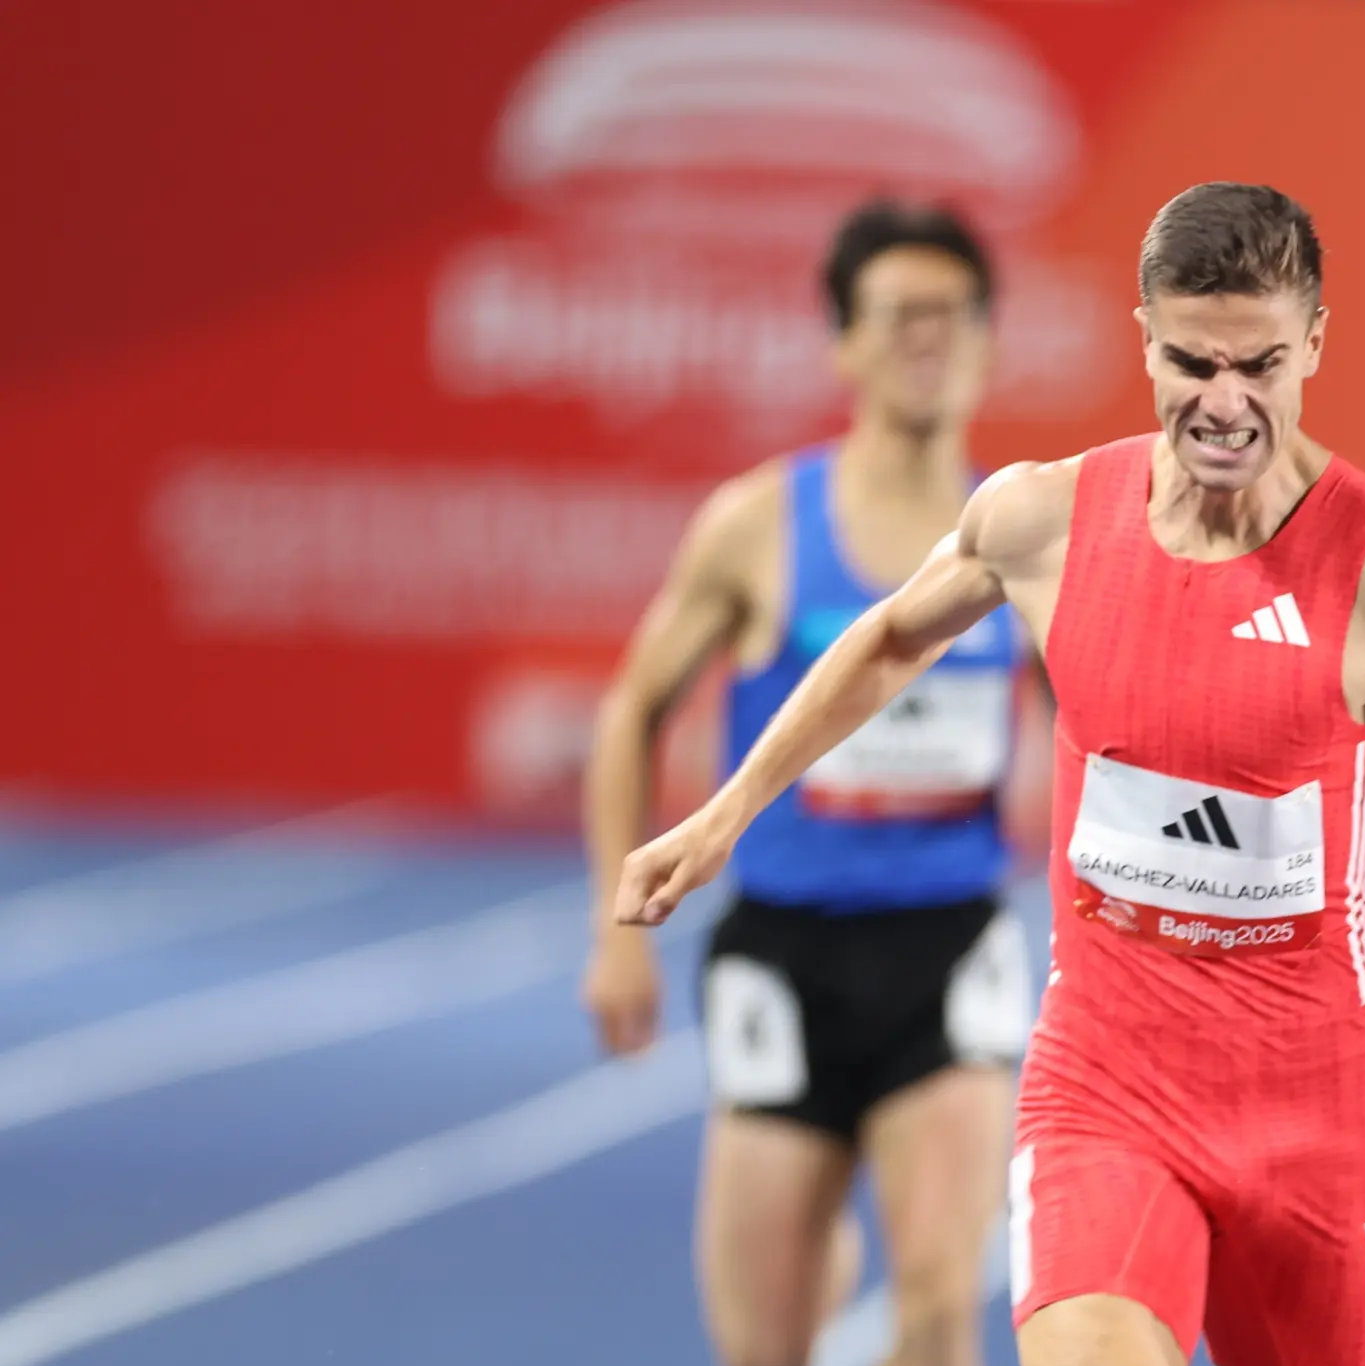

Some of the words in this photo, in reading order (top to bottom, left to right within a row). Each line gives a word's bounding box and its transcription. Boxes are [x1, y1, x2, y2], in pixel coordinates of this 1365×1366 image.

[1078, 850, 1317, 902] SÁNCHEZ-VALLADARES
[1286, 852, 1315, 871] 184
[1158, 915, 1296, 949] Beijing2025
